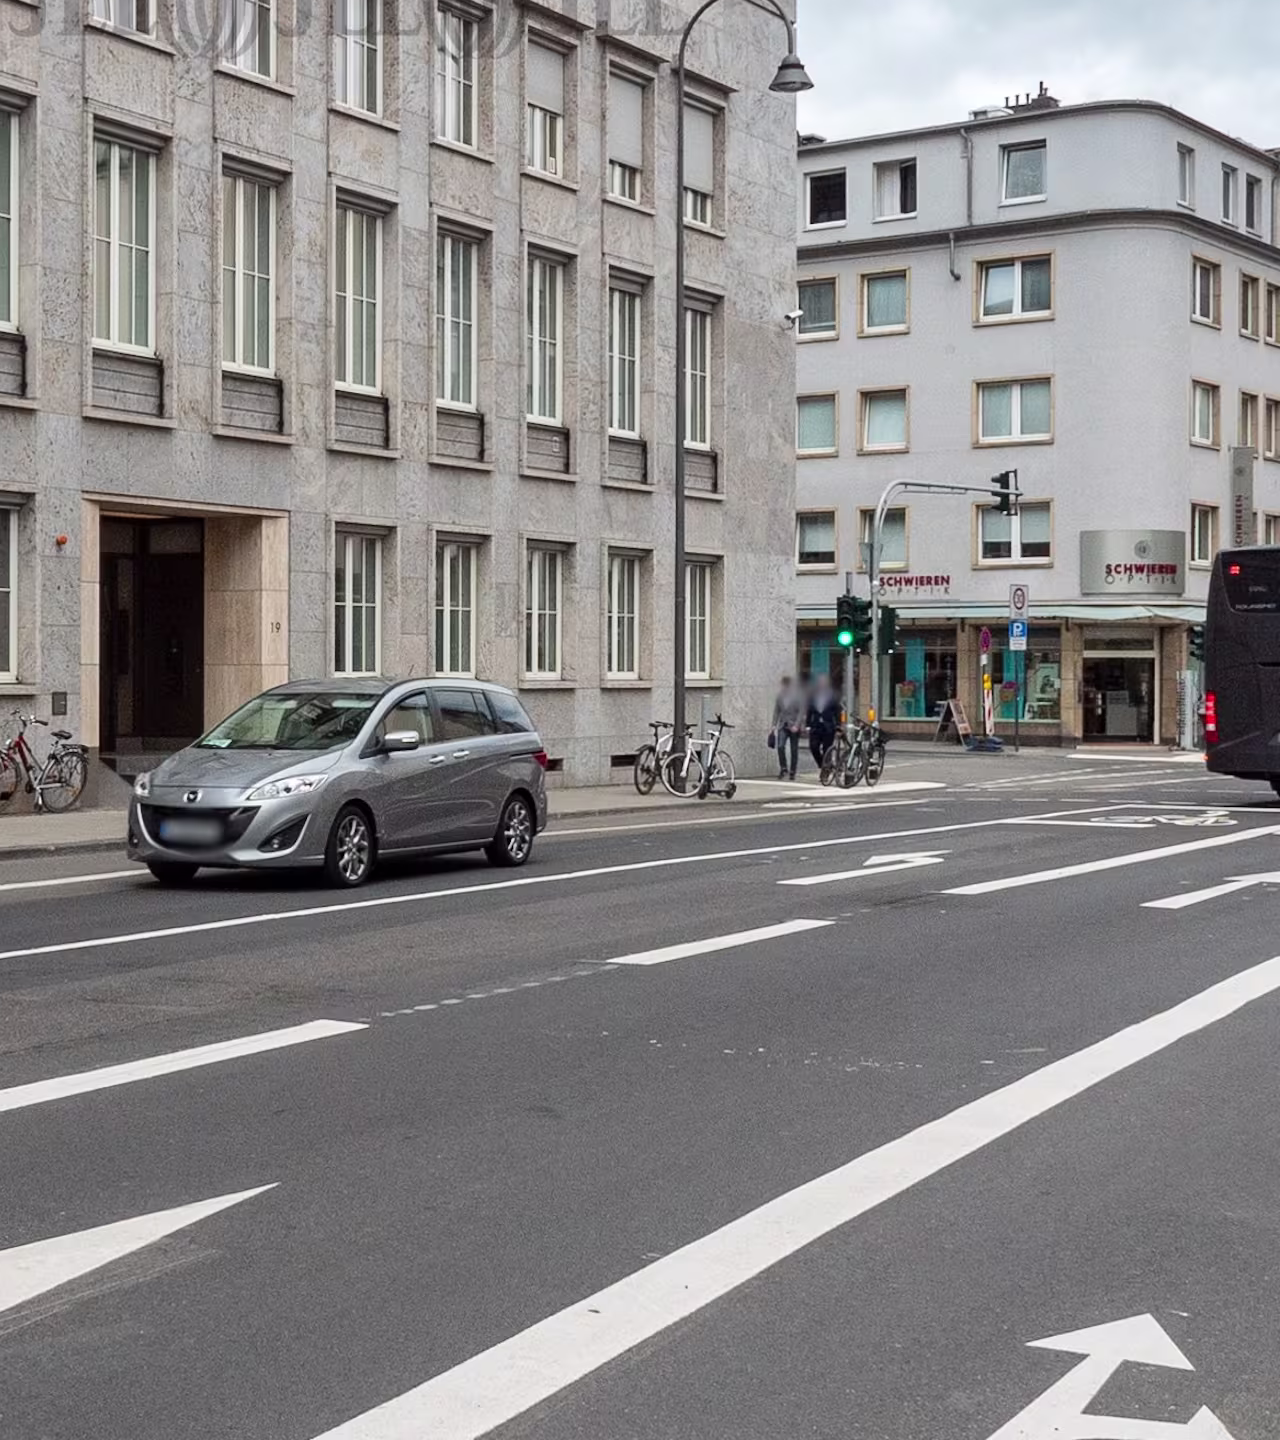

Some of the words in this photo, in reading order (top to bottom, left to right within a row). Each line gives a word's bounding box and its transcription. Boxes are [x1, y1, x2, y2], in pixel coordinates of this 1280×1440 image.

[1105, 563, 1177, 574] SCHWIEREN
[880, 574, 950, 587] SCHWIEREN
[270, 621, 281, 633] 19
